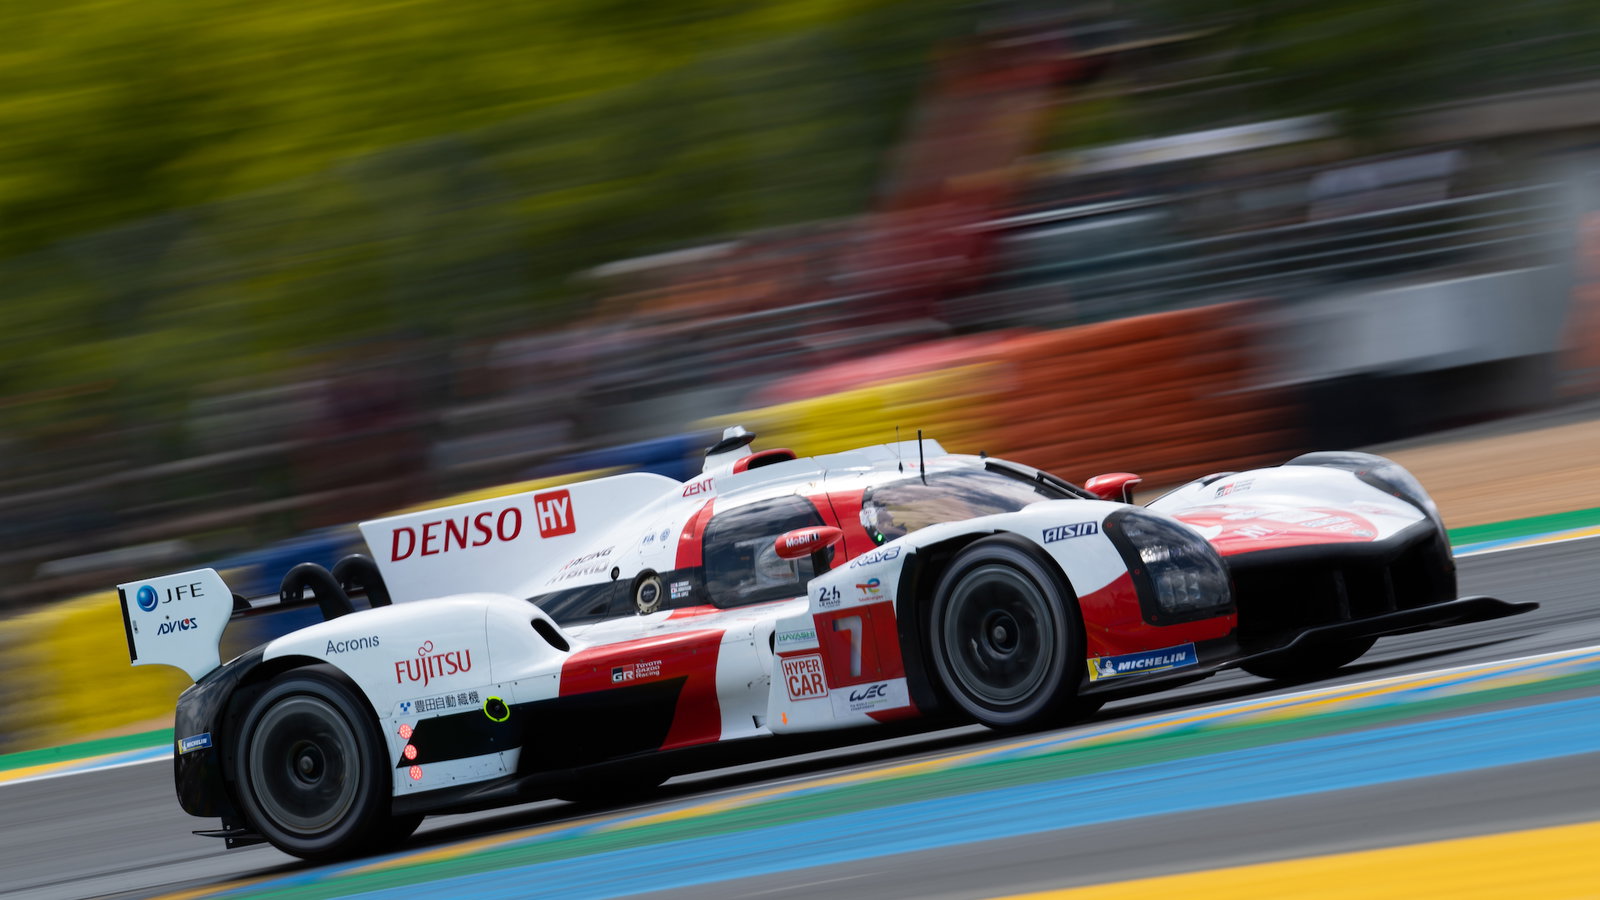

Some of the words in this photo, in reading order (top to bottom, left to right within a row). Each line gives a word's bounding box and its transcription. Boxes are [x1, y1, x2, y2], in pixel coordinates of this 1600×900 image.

[682, 477, 714, 497] ZENT
[391, 507, 522, 562] DENSO
[537, 497, 569, 532] HY
[1044, 522, 1097, 543] AISIN
[785, 535, 810, 548] Mobil
[849, 546, 901, 569] RAYS
[162, 582, 205, 604] JFE
[157, 617, 198, 636] ADVICS
[778, 630, 816, 642] HAYASHI
[325, 635, 380, 656] Acronis
[832, 615, 862, 677] 7
[394, 648, 472, 688] FUJITSU
[635, 659, 662, 669] TOYOTA
[635, 665, 660, 674] GAZOO
[784, 658, 821, 676] HYPER
[1117, 651, 1187, 671] MICHELIN
[612, 670, 634, 682] GR
[788, 673, 825, 697] CAR
[849, 683, 889, 702] WEC
